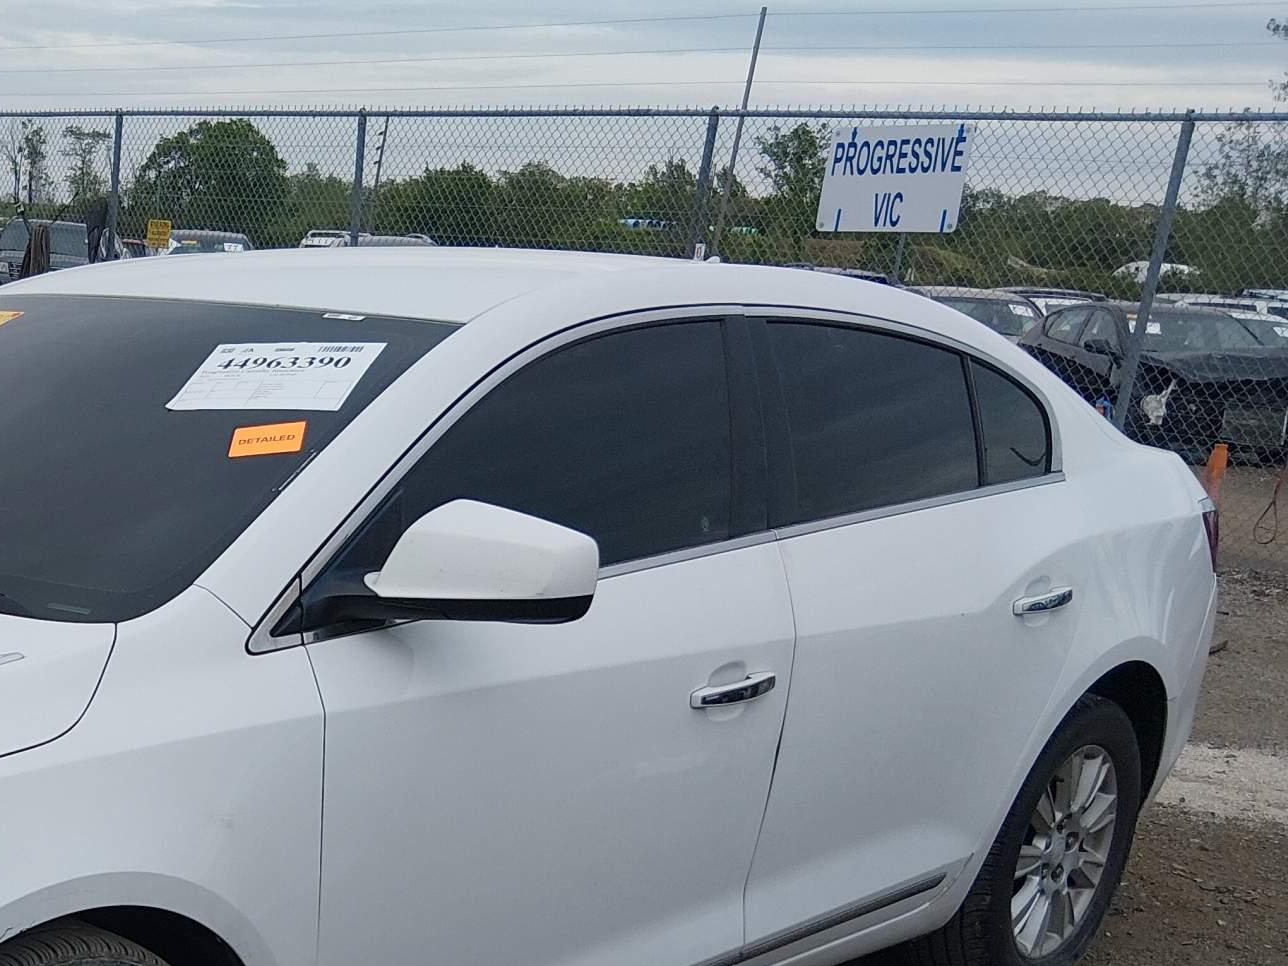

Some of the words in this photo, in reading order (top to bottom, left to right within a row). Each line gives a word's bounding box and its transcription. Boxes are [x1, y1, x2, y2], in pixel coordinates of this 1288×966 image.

[831, 136, 966, 176] PROGRESSIVE
[873, 192, 904, 227] VIC
[217, 356, 352, 370] 44963390
[238, 434, 296, 445] DETAILED
